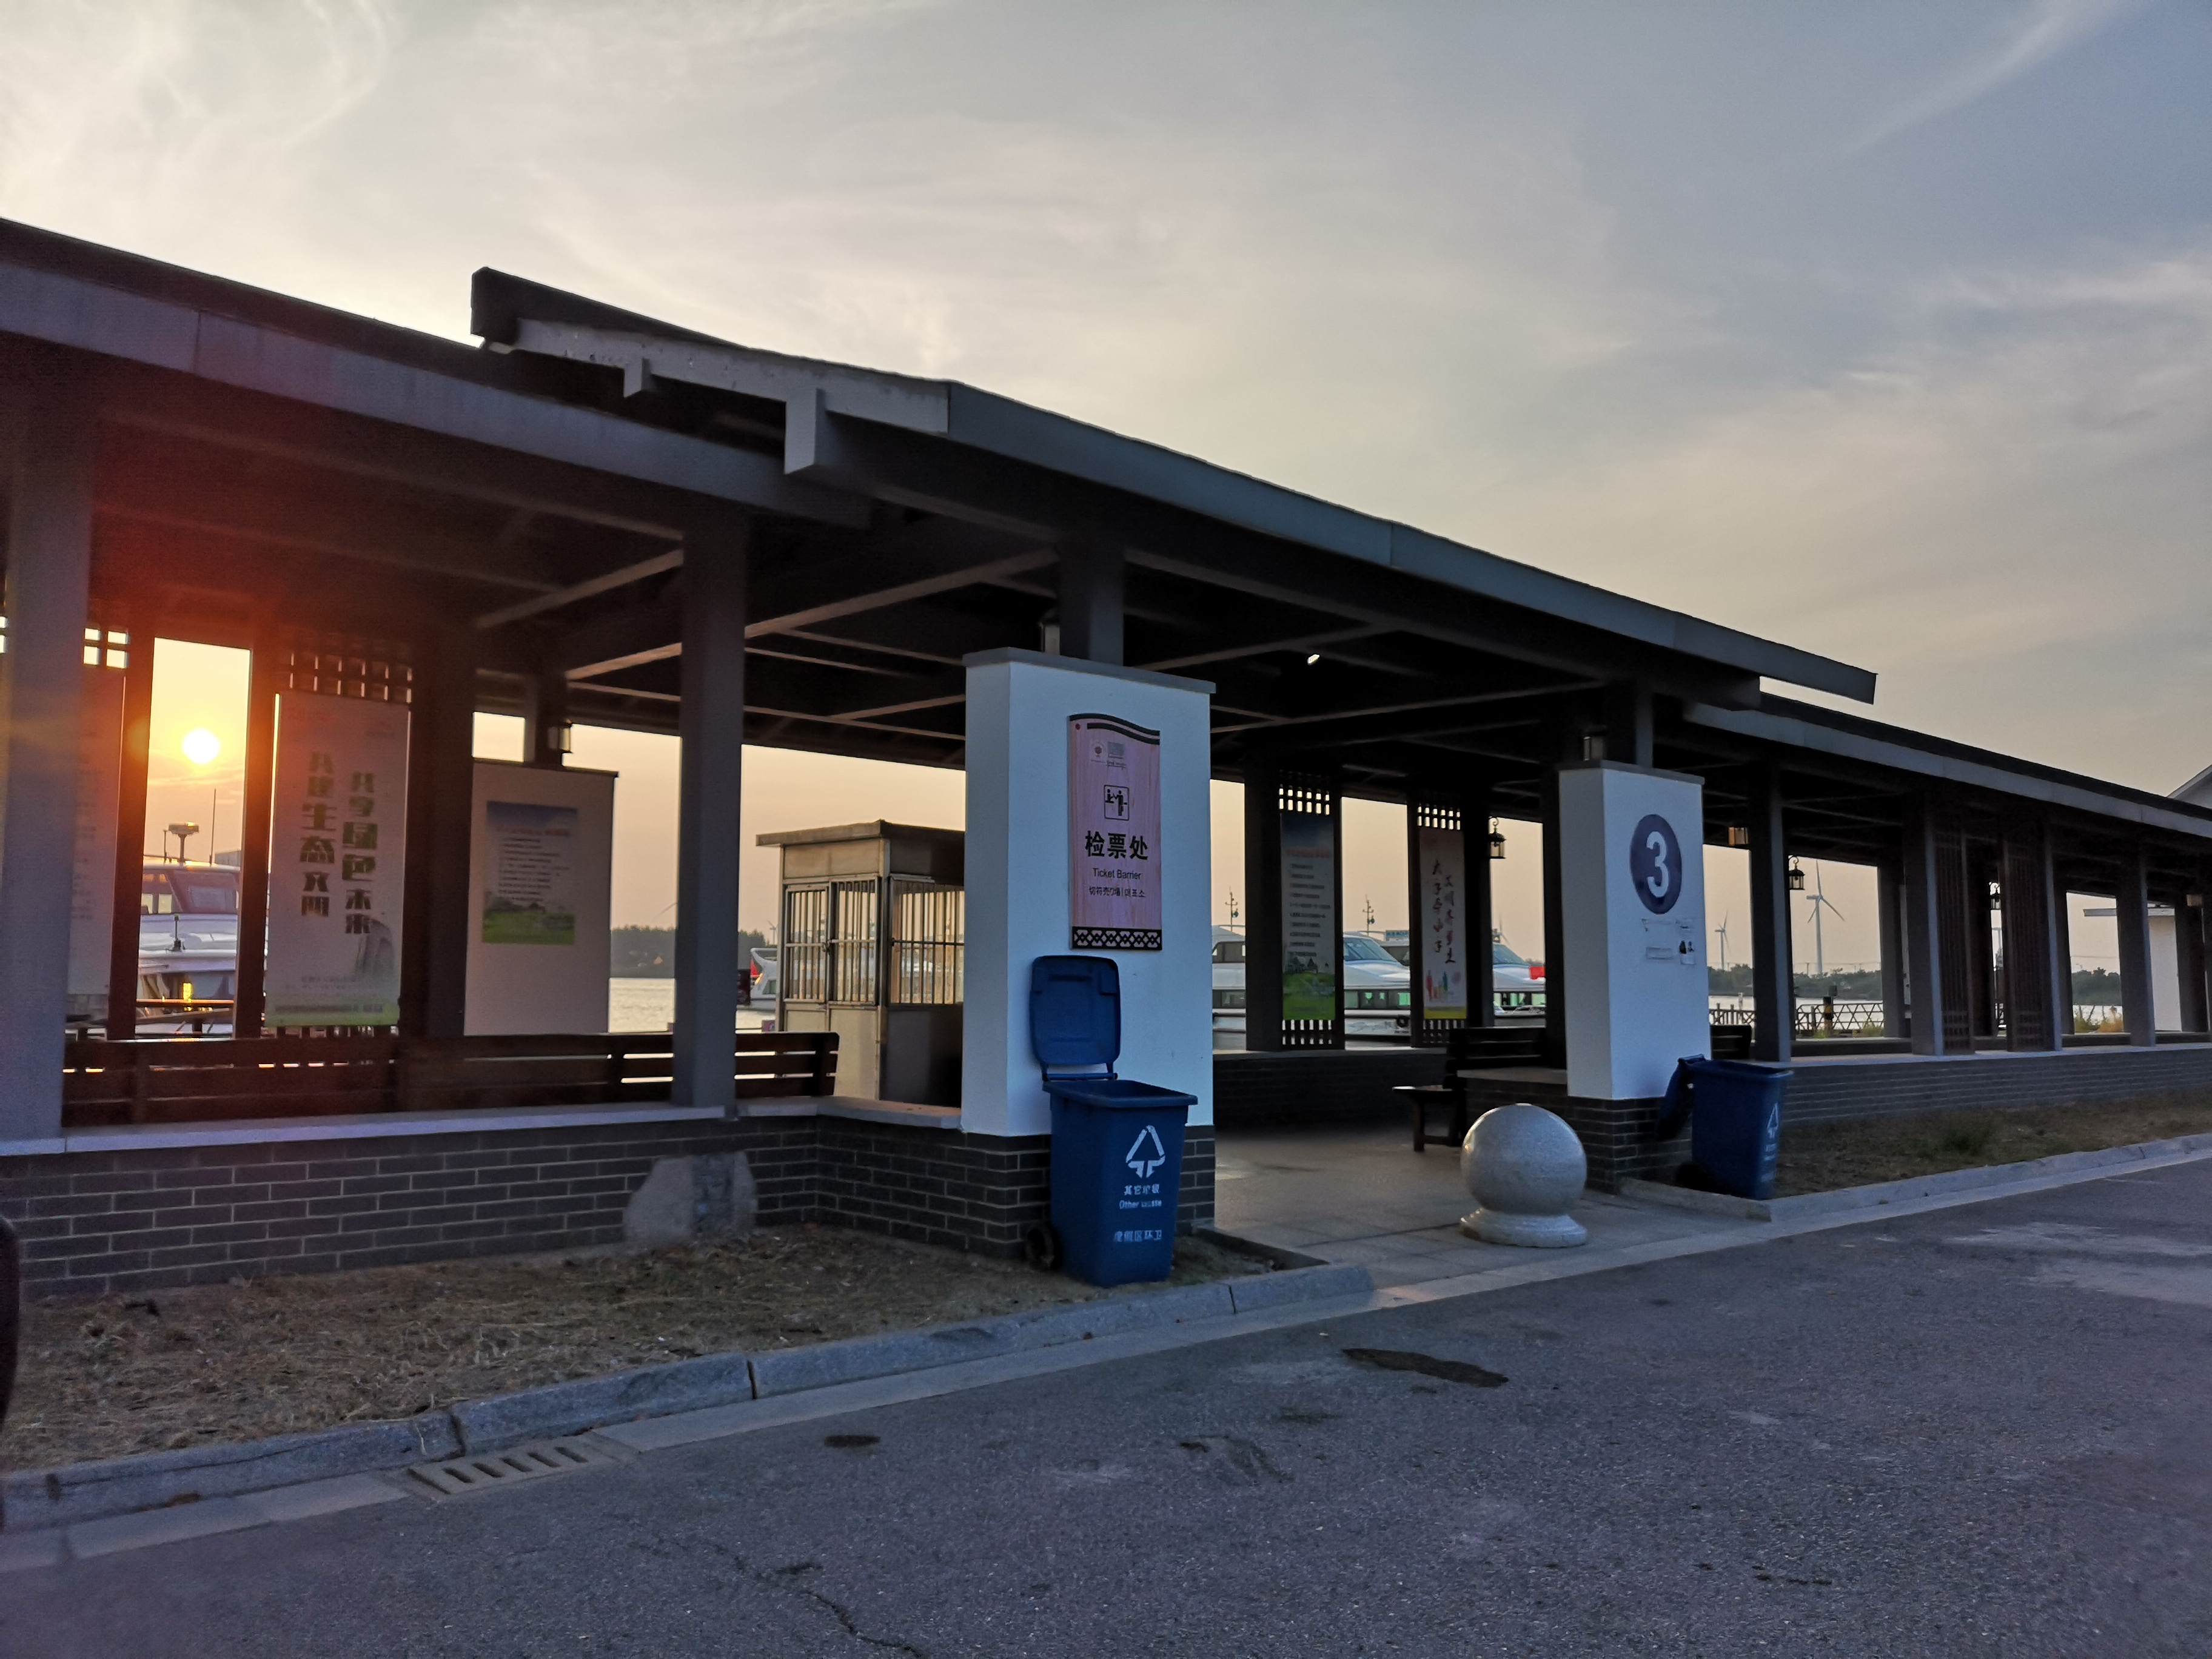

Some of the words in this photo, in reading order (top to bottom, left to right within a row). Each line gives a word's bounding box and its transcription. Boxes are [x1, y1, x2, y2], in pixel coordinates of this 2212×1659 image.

[1085, 830, 1148, 860] 检票处
[1092, 867, 1115, 879] Ticket
[1116, 868, 1142, 880] Barrier
[1646, 831, 1669, 898] 3
[1119, 1200, 1139, 1209] Other
